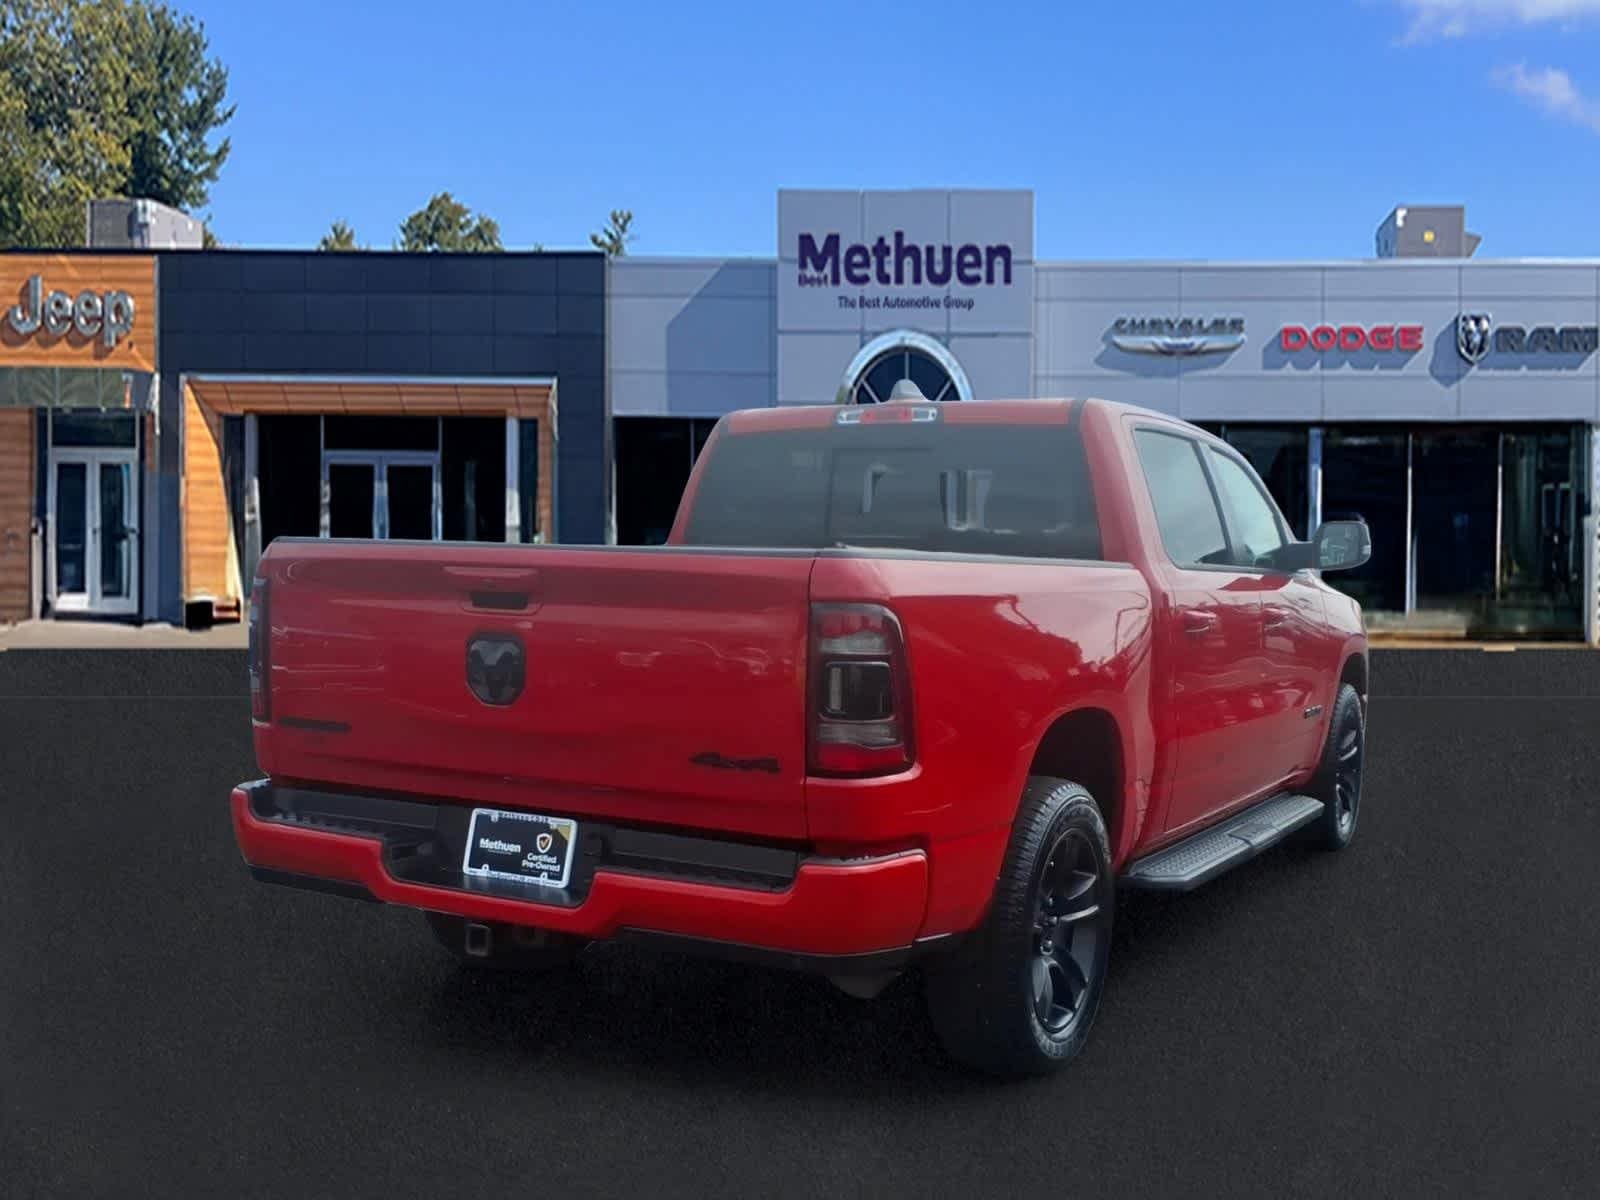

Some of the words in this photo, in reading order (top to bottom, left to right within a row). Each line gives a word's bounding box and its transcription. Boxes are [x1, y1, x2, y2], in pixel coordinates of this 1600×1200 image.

[798, 230, 1012, 286] Methuen
[9, 275, 135, 347] Jeep
[837, 295, 857, 309] The
[859, 295, 881, 309] Best
[882, 295, 942, 309] Automotive
[943, 295, 975, 312] Group
[1281, 325, 1424, 351] DODGE
[1494, 327, 1599, 352] RAM
[480, 838, 521, 853] Methuen
[521, 860, 561, 872] Pre-Owned
[527, 852, 557, 864] Certified
